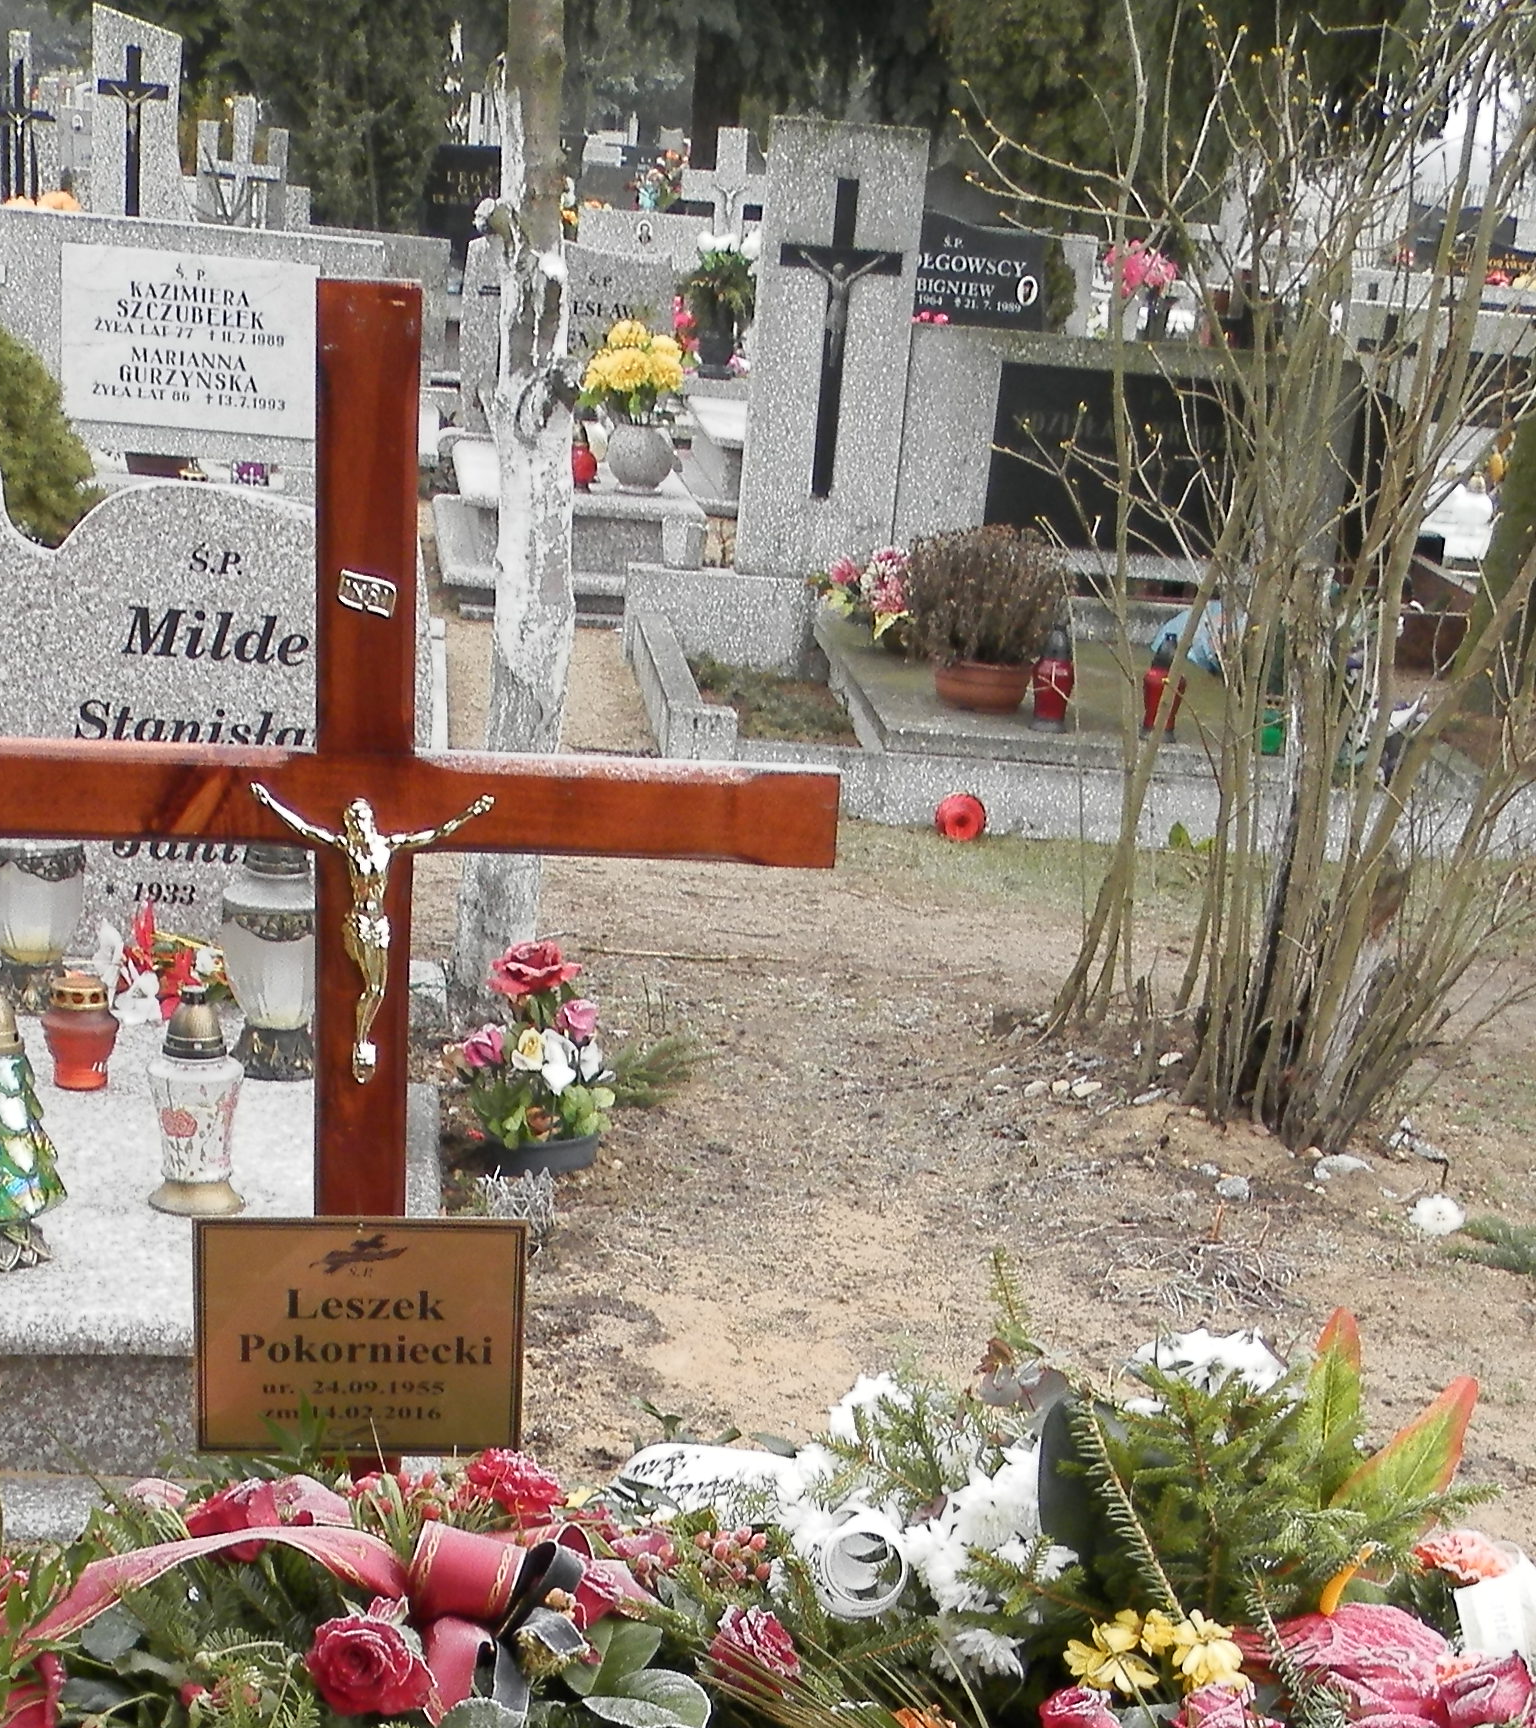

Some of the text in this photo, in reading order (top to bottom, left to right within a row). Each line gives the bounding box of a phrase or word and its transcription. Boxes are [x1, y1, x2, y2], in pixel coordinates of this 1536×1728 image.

[129, 280, 250, 308] KAZIMIERA
[917, 276, 995, 297] BIGNIEW
[116, 298, 265, 331] SZCZUBEŁEK
[175, 327, 194, 339] 77
[130, 345, 247, 372] MARIANNA
[118, 363, 259, 394] GURZYŃSKA
[188, 541, 243, 576] Ś.P.
[120, 605, 310, 667] Milde
[73, 698, 316, 747] Stanisła
[133, 881, 196, 906] 1933
[286, 1288, 446, 1322] Leszek
[238, 1333, 494, 1367] Pokorniecki
[262, 1379, 446, 1397] ur. 24.09.1955
